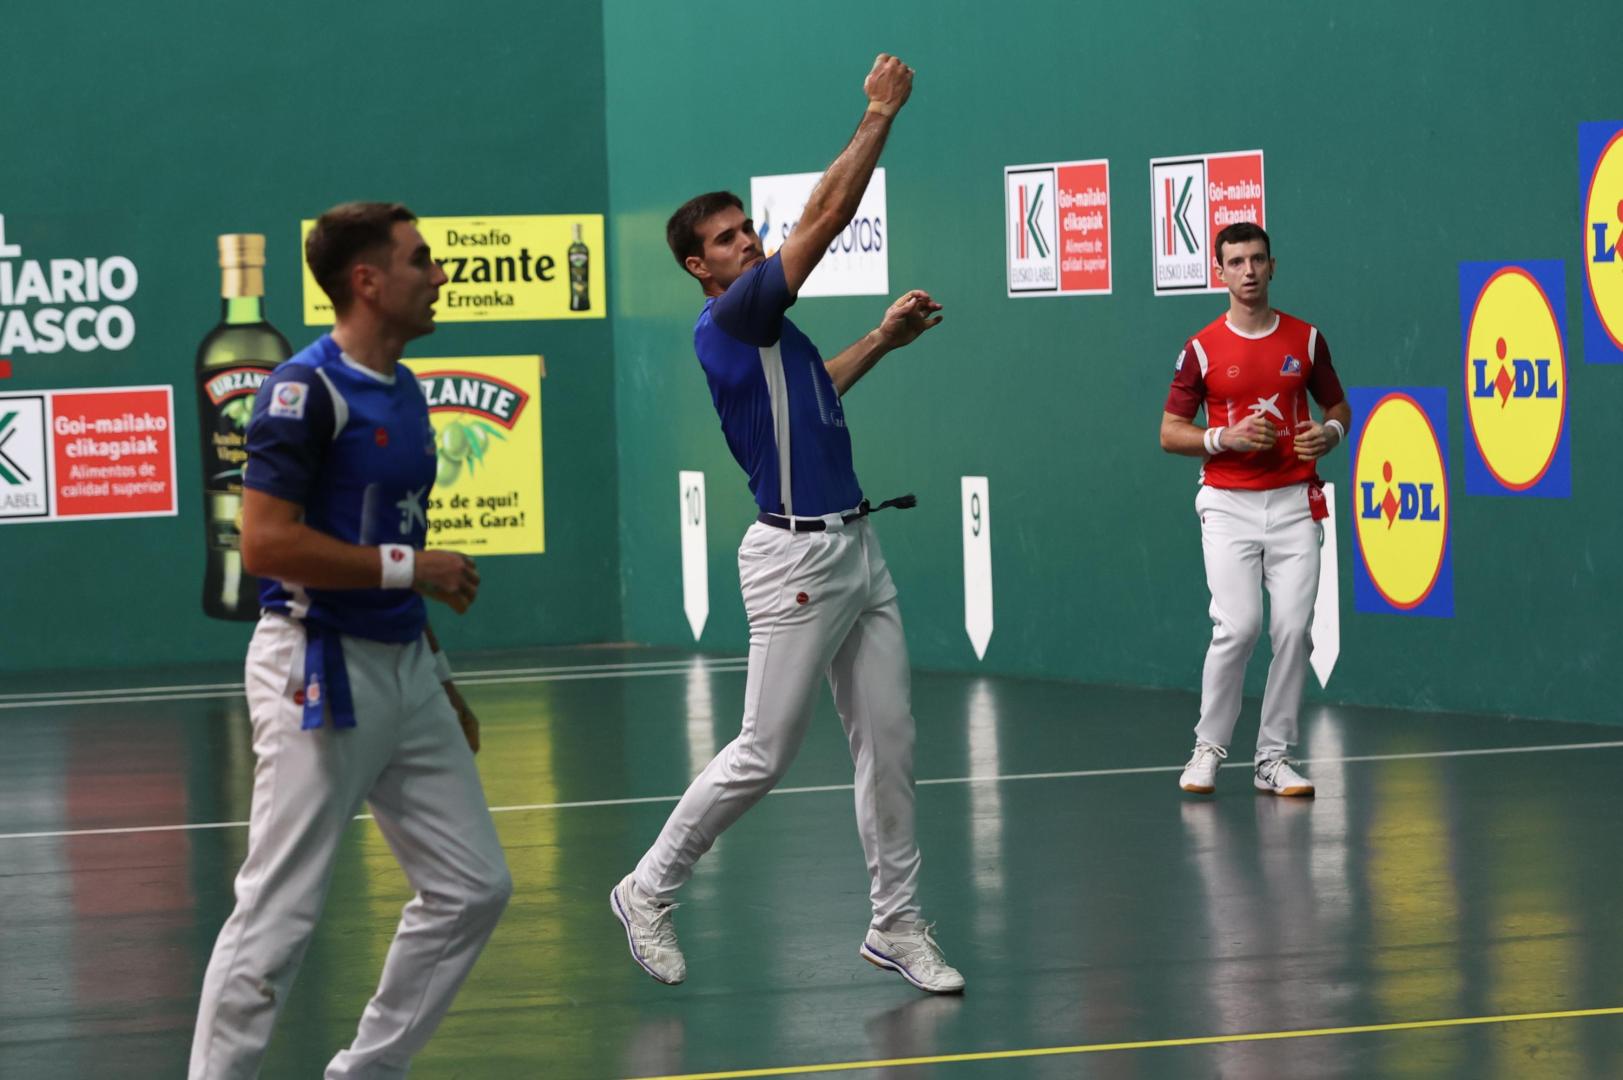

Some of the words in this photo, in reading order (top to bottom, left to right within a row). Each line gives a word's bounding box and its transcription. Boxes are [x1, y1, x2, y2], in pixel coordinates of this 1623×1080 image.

[1059, 187, 1107, 208] Goi-mailako
[1209, 179, 1261, 202] Goi-mailako
[1063, 211, 1103, 235] elikagaiak
[0, 213, 21, 257] L
[434, 248, 555, 283] rzante
[1159, 264, 1182, 281] EUSKO
[1183, 263, 1204, 280] LABEL
[0, 256, 138, 305] IARIO
[447, 290, 514, 307] Erronka
[210, 371, 270, 397] URZAN
[420, 378, 515, 419] ZANTE
[55, 413, 167, 435] Goi-mailako
[65, 436, 158, 460] elikagaiak
[70, 464, 136, 479] Alimentos
[139, 462, 156, 477] de
[0, 492, 39, 509] ABEL
[61, 481, 110, 497] calidad
[112, 480, 166, 498] superior
[450, 493, 469, 509] de
[685, 485, 701, 526] 10
[427, 513, 473, 533] ngoak
[480, 511, 525, 528] Gara!
[970, 492, 981, 537] 9
